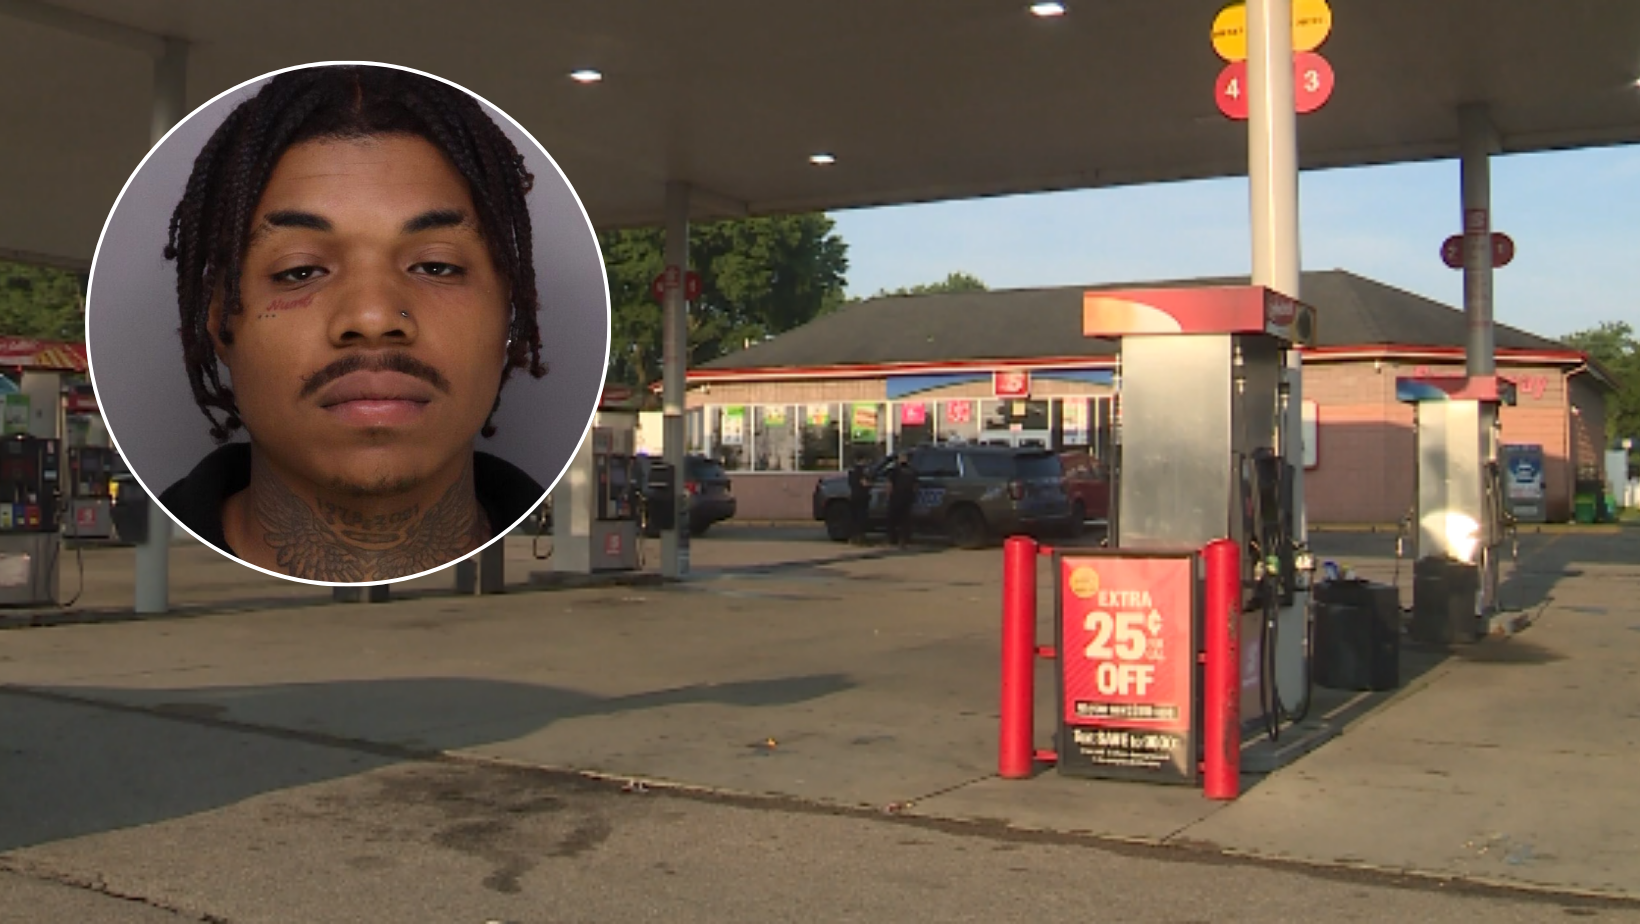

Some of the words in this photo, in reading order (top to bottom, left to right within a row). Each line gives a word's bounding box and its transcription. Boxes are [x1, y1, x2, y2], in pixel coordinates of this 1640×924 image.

[1224, 77, 1240, 99] 4
[1304, 70, 1320, 92] 3
[1098, 590, 1152, 608] EXTRA
[1097, 662, 1155, 696] OFF
